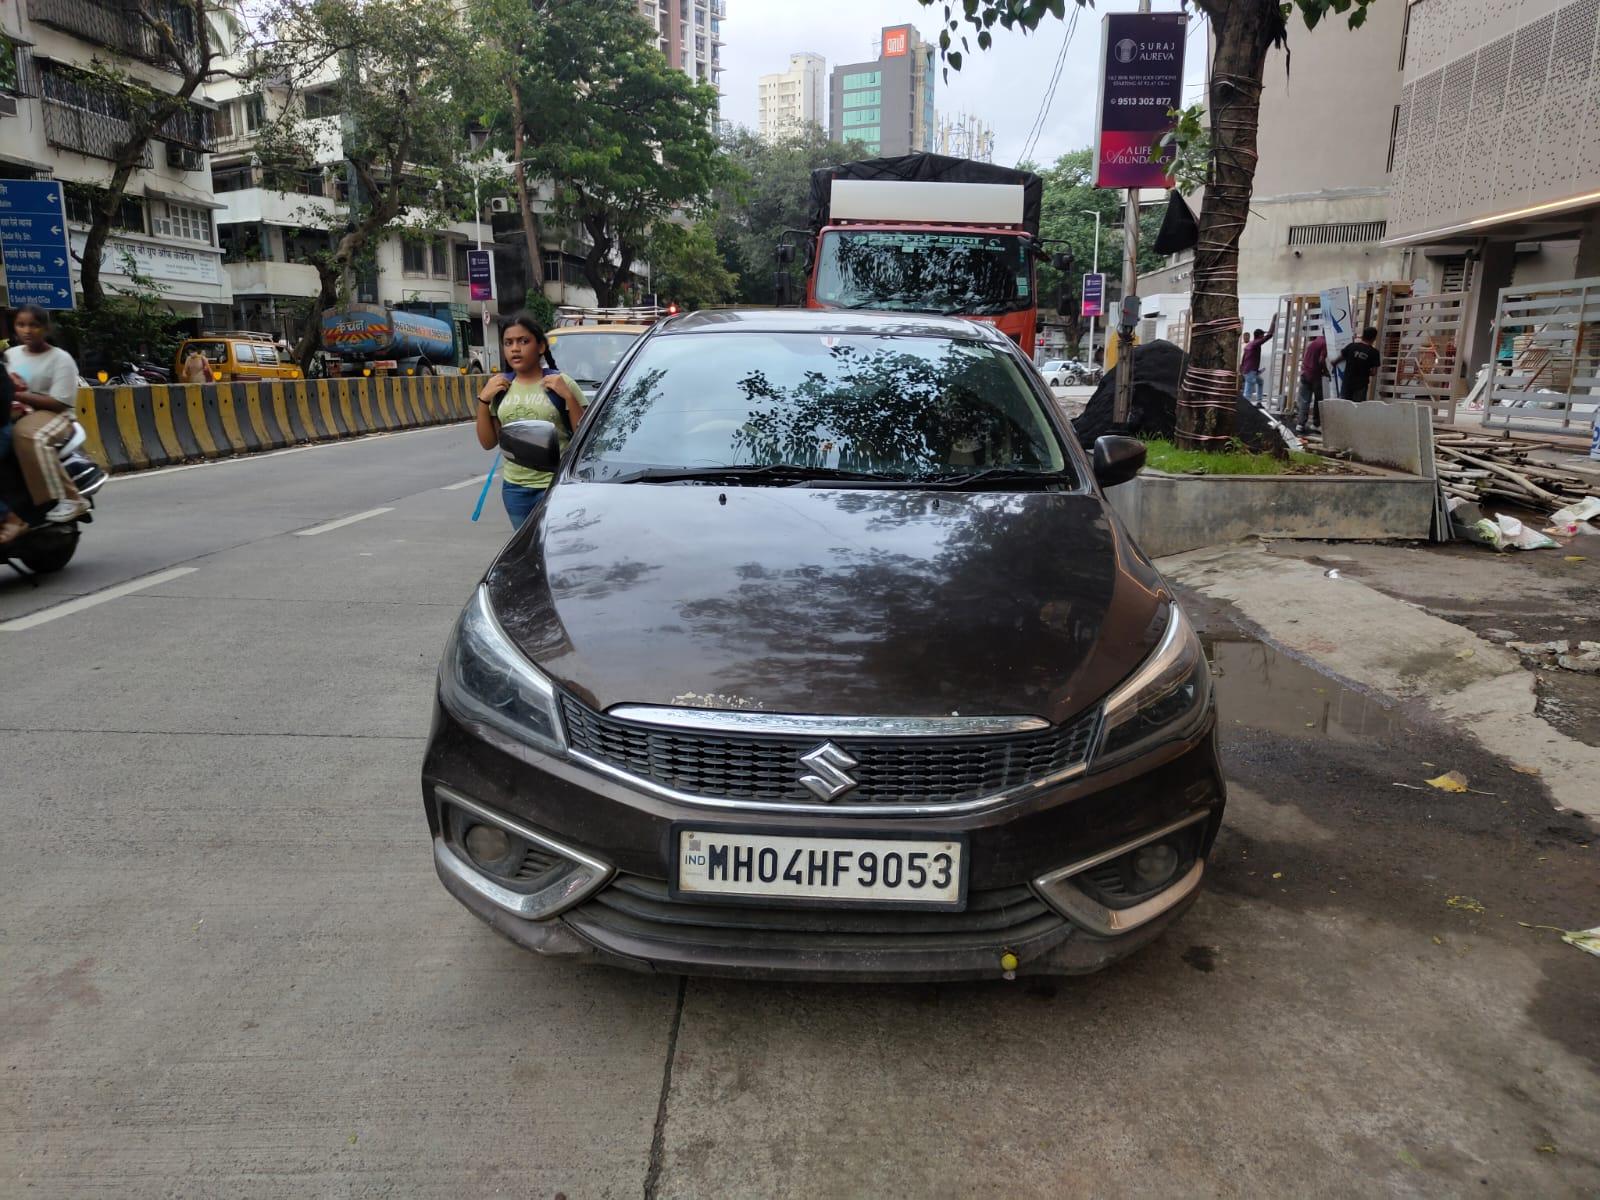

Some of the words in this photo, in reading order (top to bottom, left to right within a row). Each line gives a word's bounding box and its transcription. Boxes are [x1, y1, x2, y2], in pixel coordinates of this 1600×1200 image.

[1139, 42, 1175, 51] SURAJ
[1139, 52, 1174, 61] AUREVA
[1117, 97, 1137, 106] 9513
[1138, 97, 1154, 106] 302
[1156, 97, 1172, 106] 877
[1126, 146, 1133, 155] A
[1134, 146, 1152, 155] LIFE
[925, 235, 985, 245] POINT
[685, 855, 706, 866] IND
[708, 844, 952, 890] MH04HF9053
